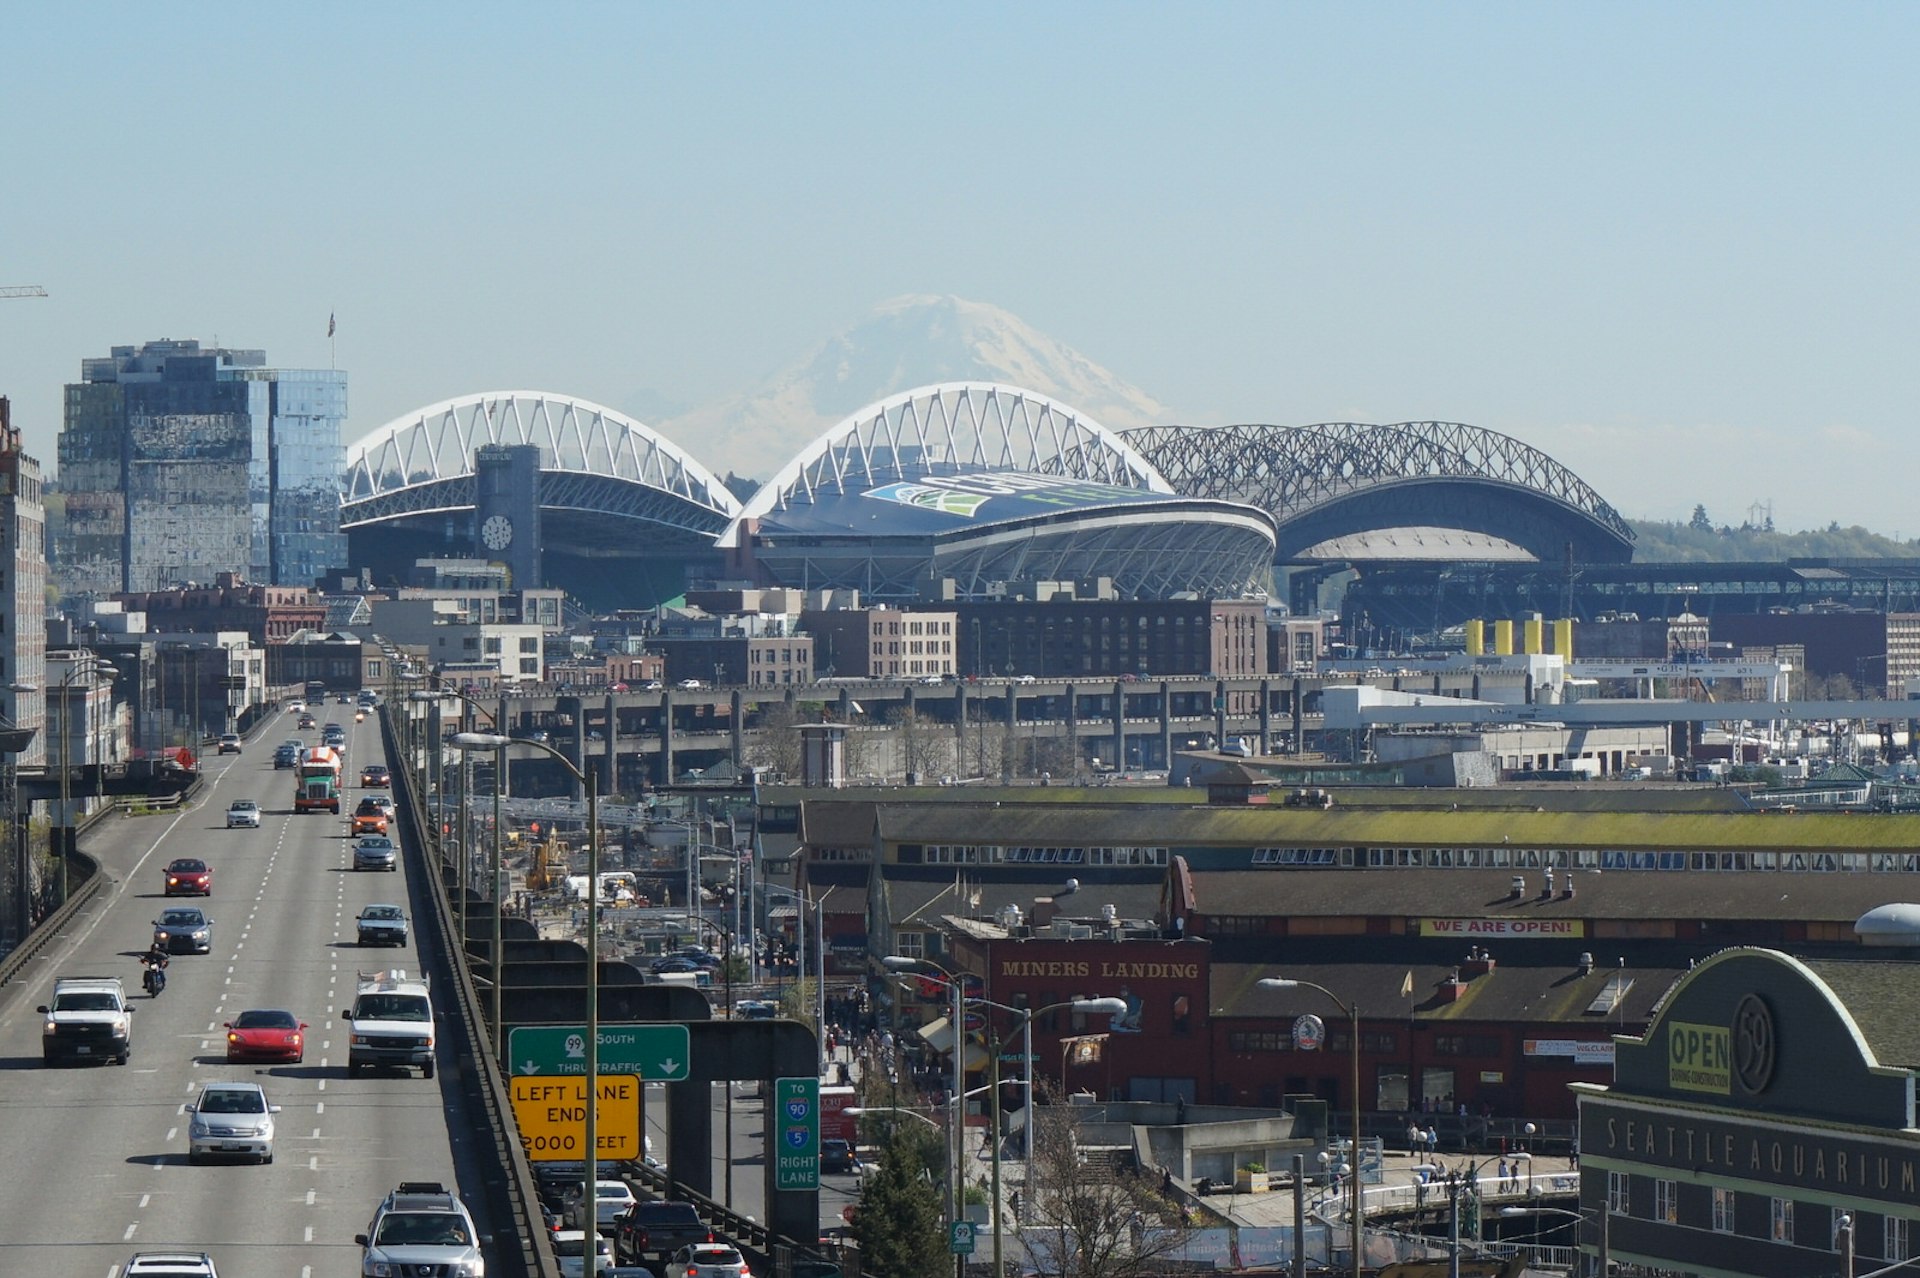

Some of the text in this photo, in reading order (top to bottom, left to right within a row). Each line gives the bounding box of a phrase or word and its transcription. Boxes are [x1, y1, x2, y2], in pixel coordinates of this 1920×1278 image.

[1433, 921, 1572, 933] WE ARE OPEN!
[1002, 961, 1199, 979] MINERS LANDING
[568, 1034, 635, 1049] 99 SOUTH
[1741, 1011, 1766, 1076] 59
[1672, 1028, 1728, 1069] OPEN
[517, 1087, 566, 1100] LEFT
[790, 1084, 805, 1094] TO
[548, 1107, 600, 1122] END
[790, 1104, 805, 1115] 90
[522, 1136, 627, 1150] 2000 EET
[794, 1132, 802, 1144] 5
[1608, 1118, 1915, 1193] SEATTLE AQUARIUM
[780, 1157, 815, 1168] RIGHT
[781, 1172, 814, 1183] LANE
[957, 1228, 968, 1237] 99
